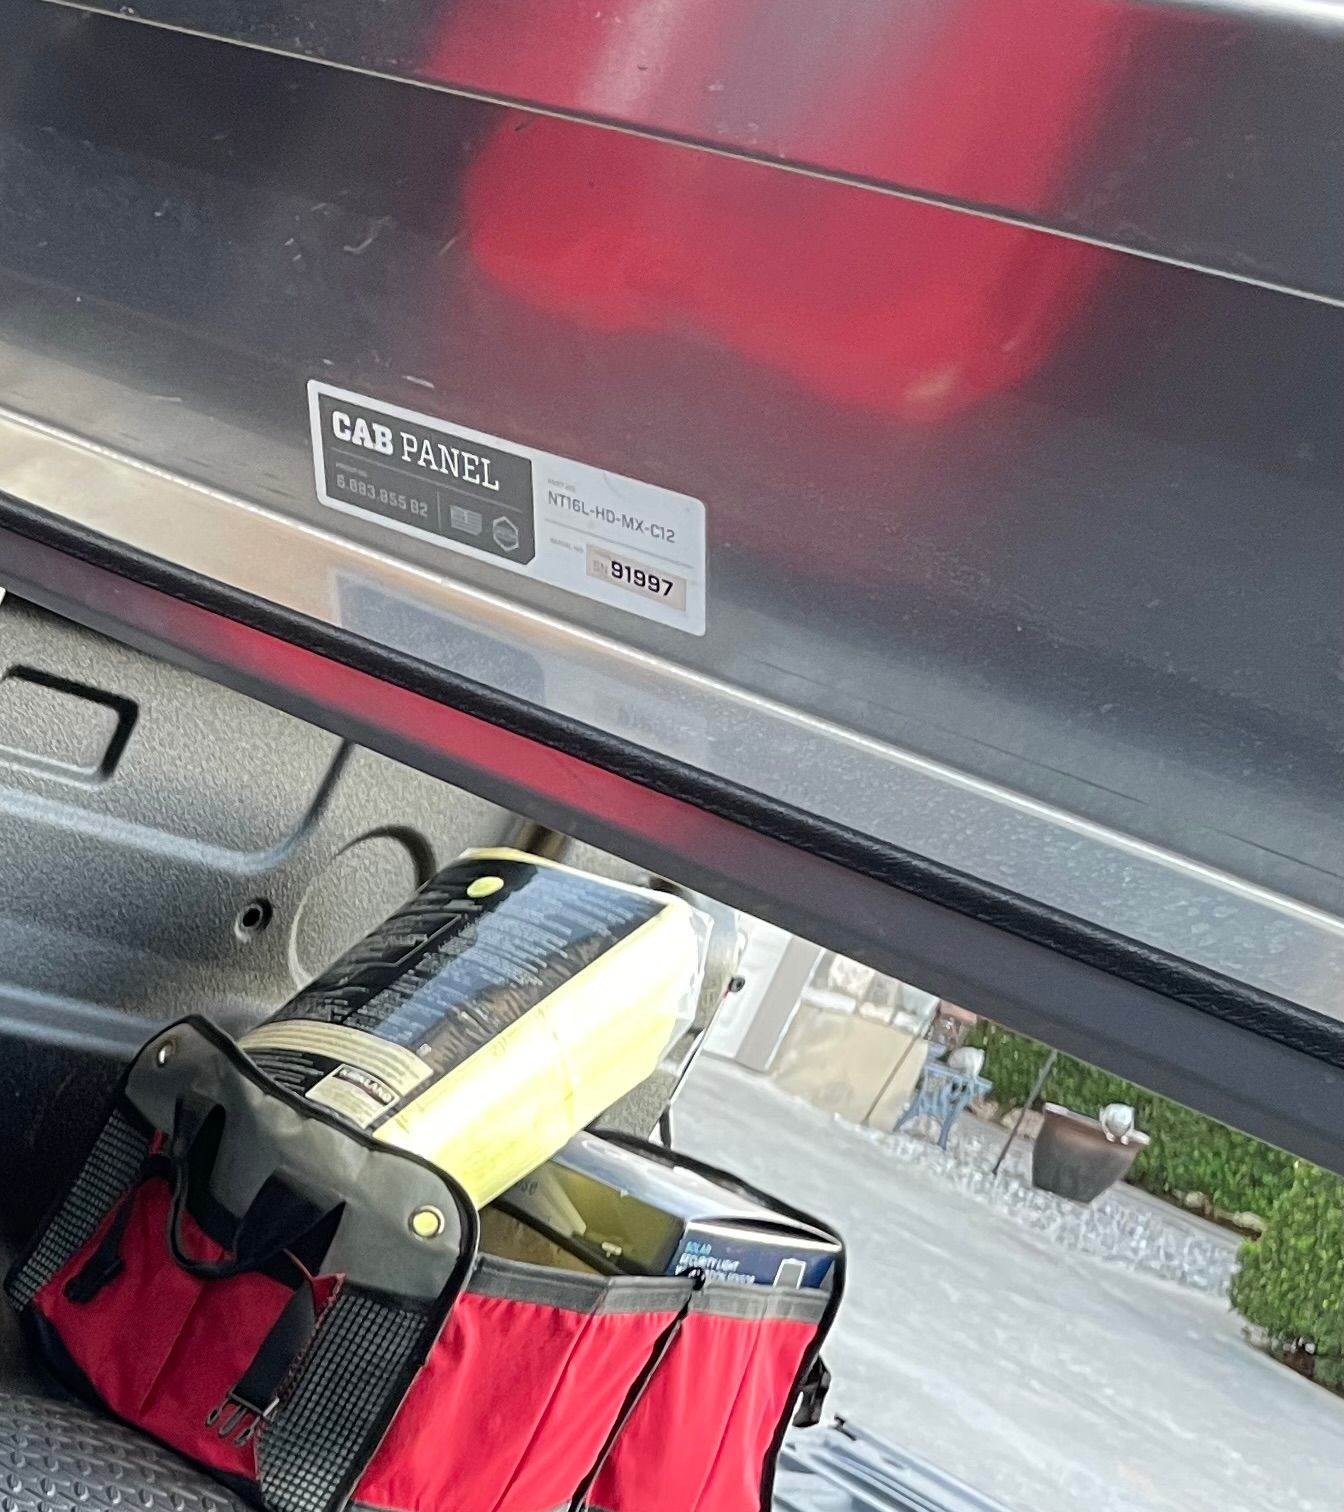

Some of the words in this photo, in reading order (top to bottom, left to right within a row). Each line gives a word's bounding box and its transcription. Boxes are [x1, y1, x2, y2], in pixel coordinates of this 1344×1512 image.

[331, 410, 394, 456] CAB
[399, 431, 500, 492] PANEL
[547, 489, 676, 544] NT16L-HD-MX-C12
[610, 559, 674, 597] 91997
